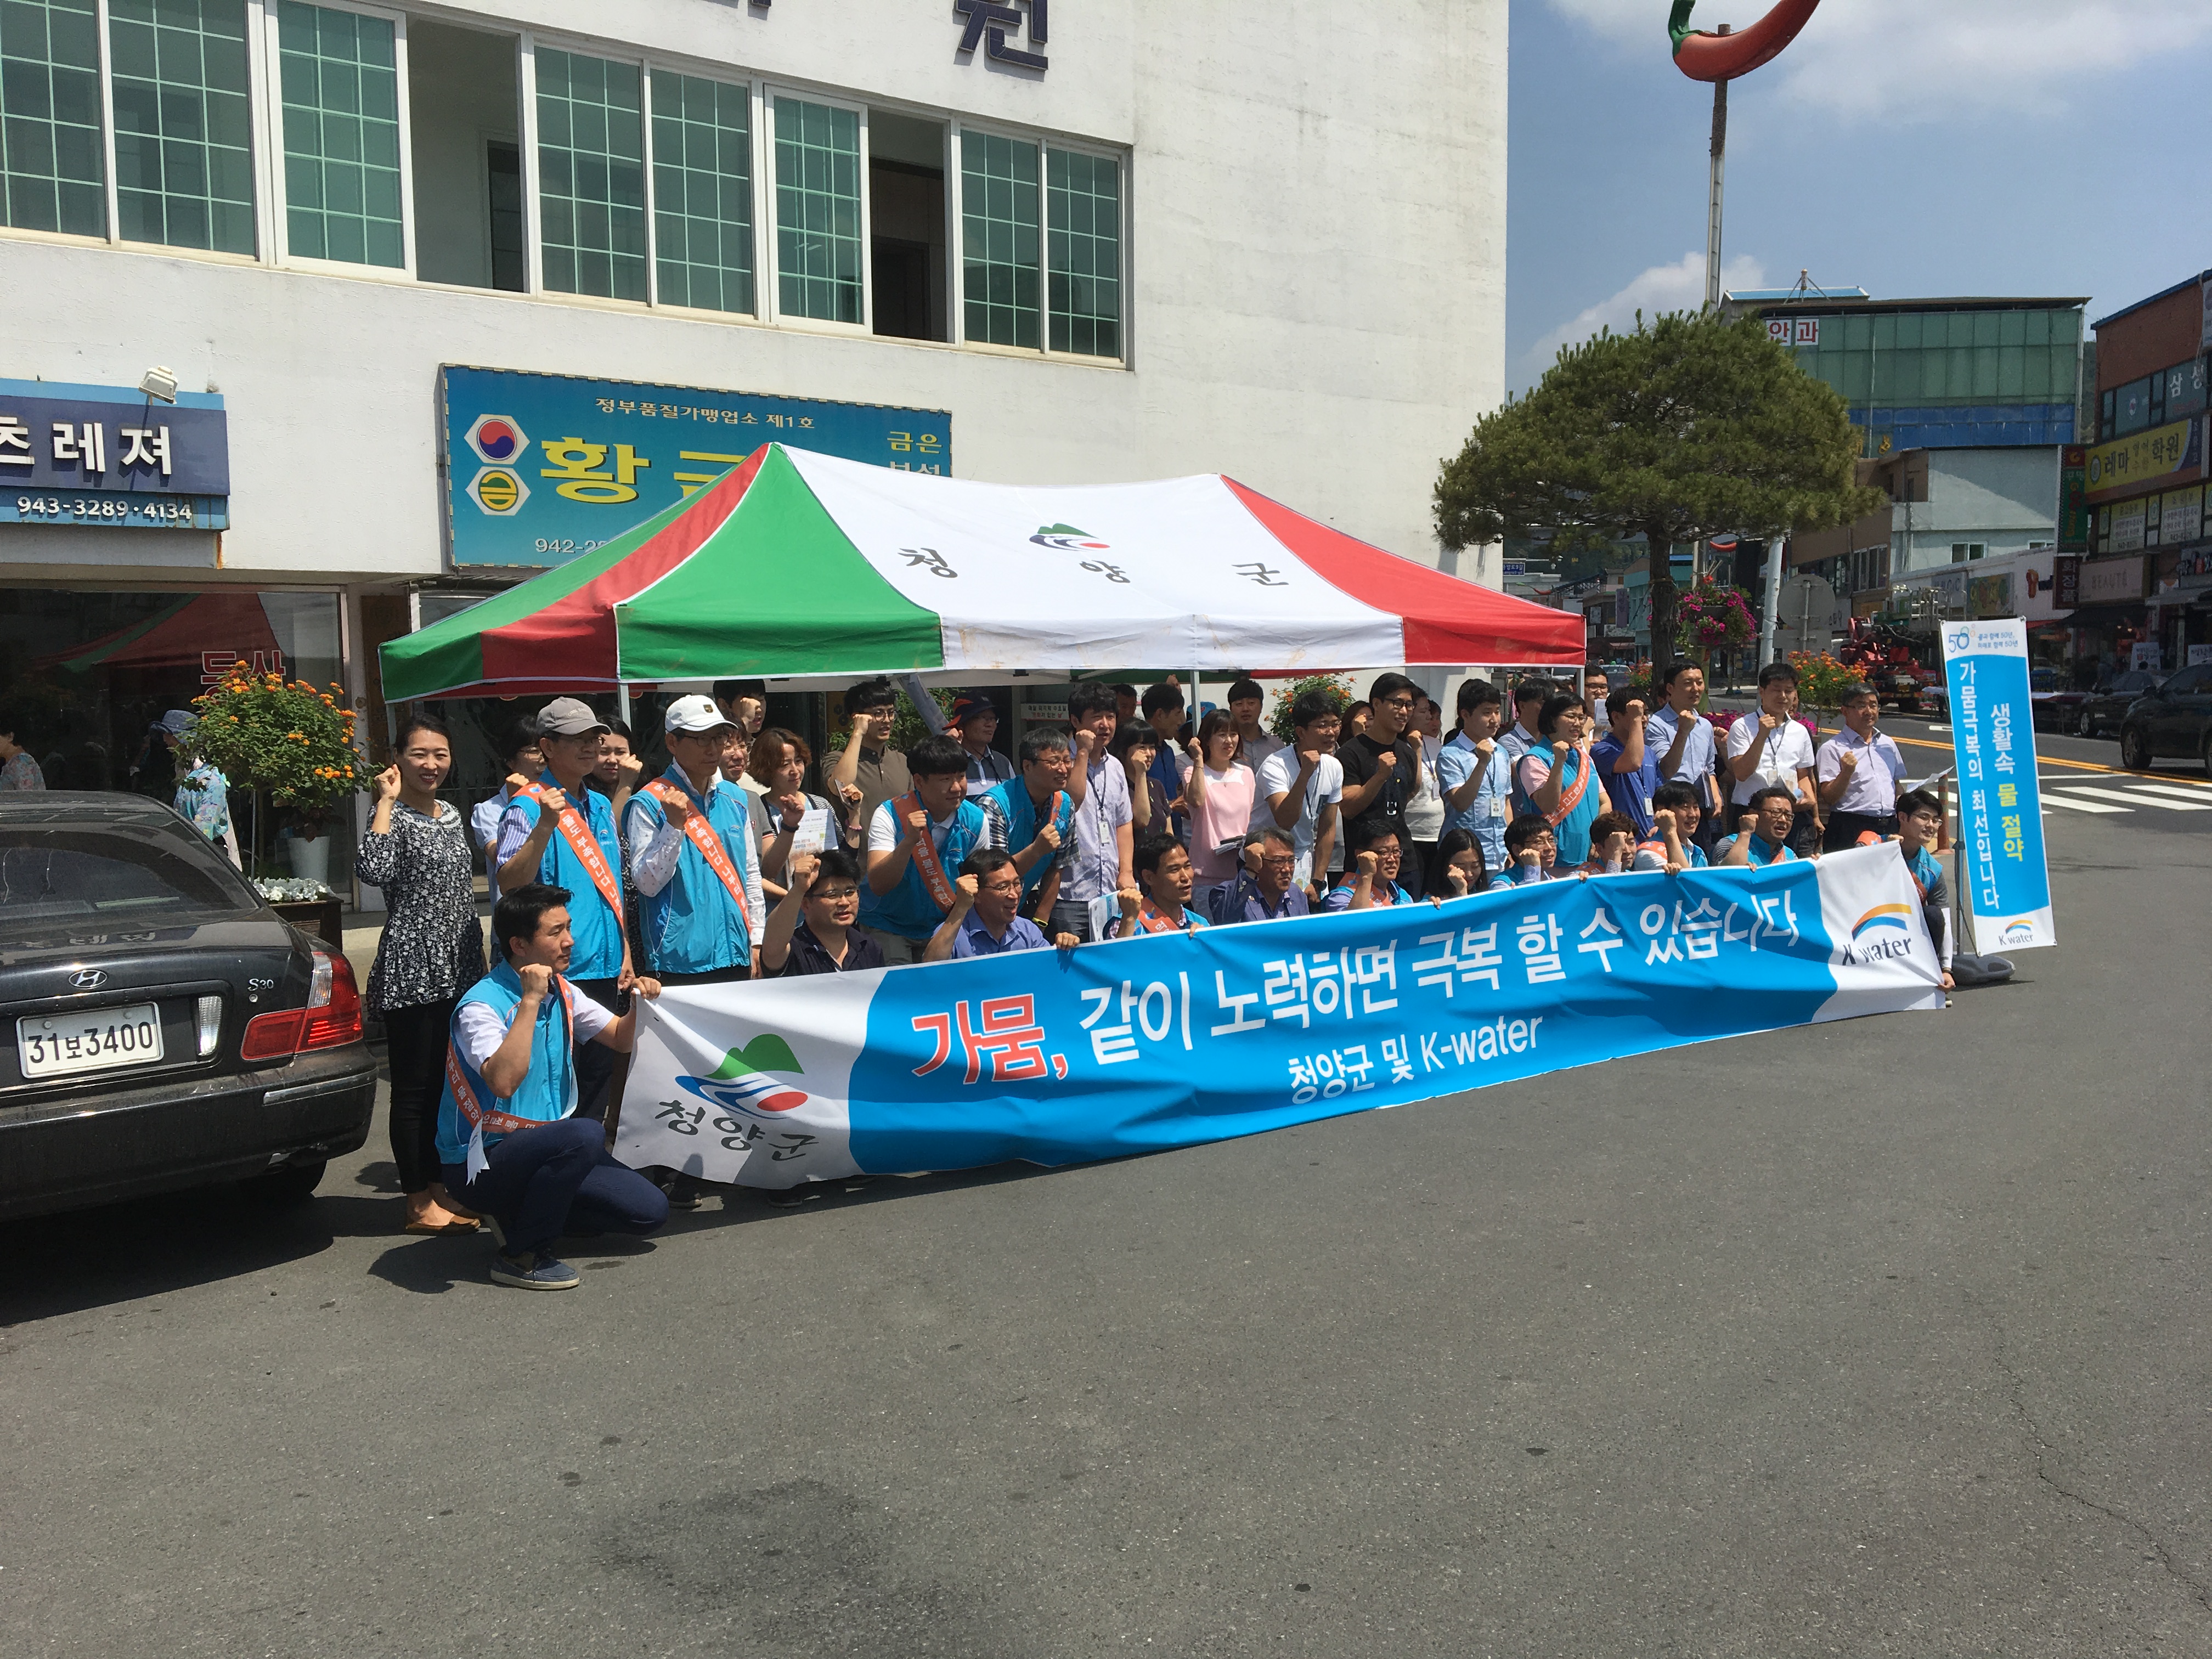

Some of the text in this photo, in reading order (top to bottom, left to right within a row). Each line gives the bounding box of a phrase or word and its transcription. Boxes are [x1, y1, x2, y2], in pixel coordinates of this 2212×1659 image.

[596, 397, 815, 430] 정부품질가맹업소 제1호
[887, 431, 942, 454] 금은
[2152, 433, 2180, 465] 학원
[1960, 661, 2000, 910] 가뭄극복의 최선입니다
[1990, 702, 2024, 862] 생활속 물 절약
[561, 814, 582, 838] 물도
[576, 836, 612, 887] 부족합니다
[688, 818, 724, 866] 부족합니다
[721, 865, 741, 896] 나부터
[1842, 937, 1912, 966] K water
[1999, 932, 2034, 946] K water
[249, 978, 274, 992] S30
[911, 889, 1799, 1086] 가뭄, 같이 노력하면 극복 할 수 있습니다
[28, 1021, 153, 1063] 31보3400
[1288, 1016, 1543, 1104] 청양군 및 K-water
[457, 1085, 467, 1101] 물
[654, 1099, 819, 1163] 청양군
